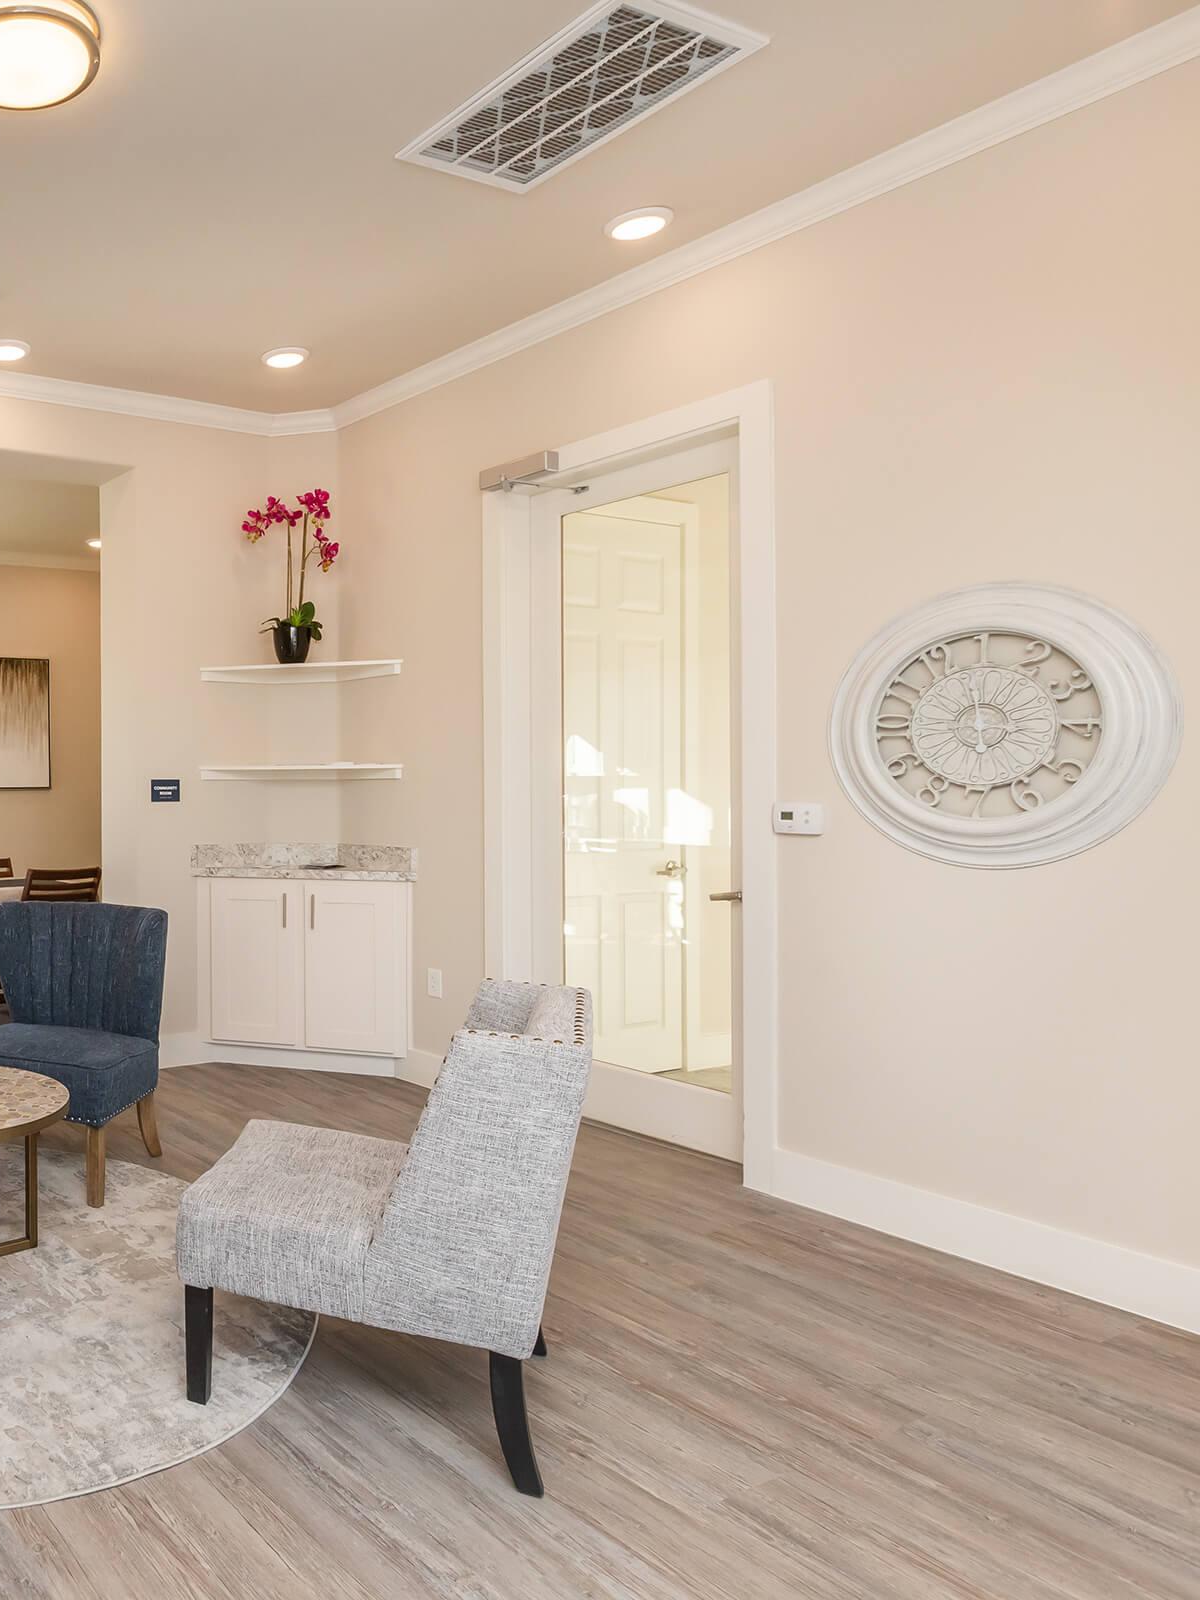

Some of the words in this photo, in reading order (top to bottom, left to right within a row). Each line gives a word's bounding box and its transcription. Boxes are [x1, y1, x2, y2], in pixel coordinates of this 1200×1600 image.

[917, 643, 960, 684] 12
[973, 633, 991, 667] 1
[1010, 640, 1052, 677] 2
[885, 674, 924, 707] 11
[1050, 669, 1092, 701] 3
[875, 713, 912, 742] 10
[1060, 715, 1102, 738] 4
[887, 752, 923, 779] 9
[1041, 748, 1083, 783] 5
[916, 776, 949, 808] 8
[963, 784, 997, 818] 7
[1010, 777, 1043, 811] 6
